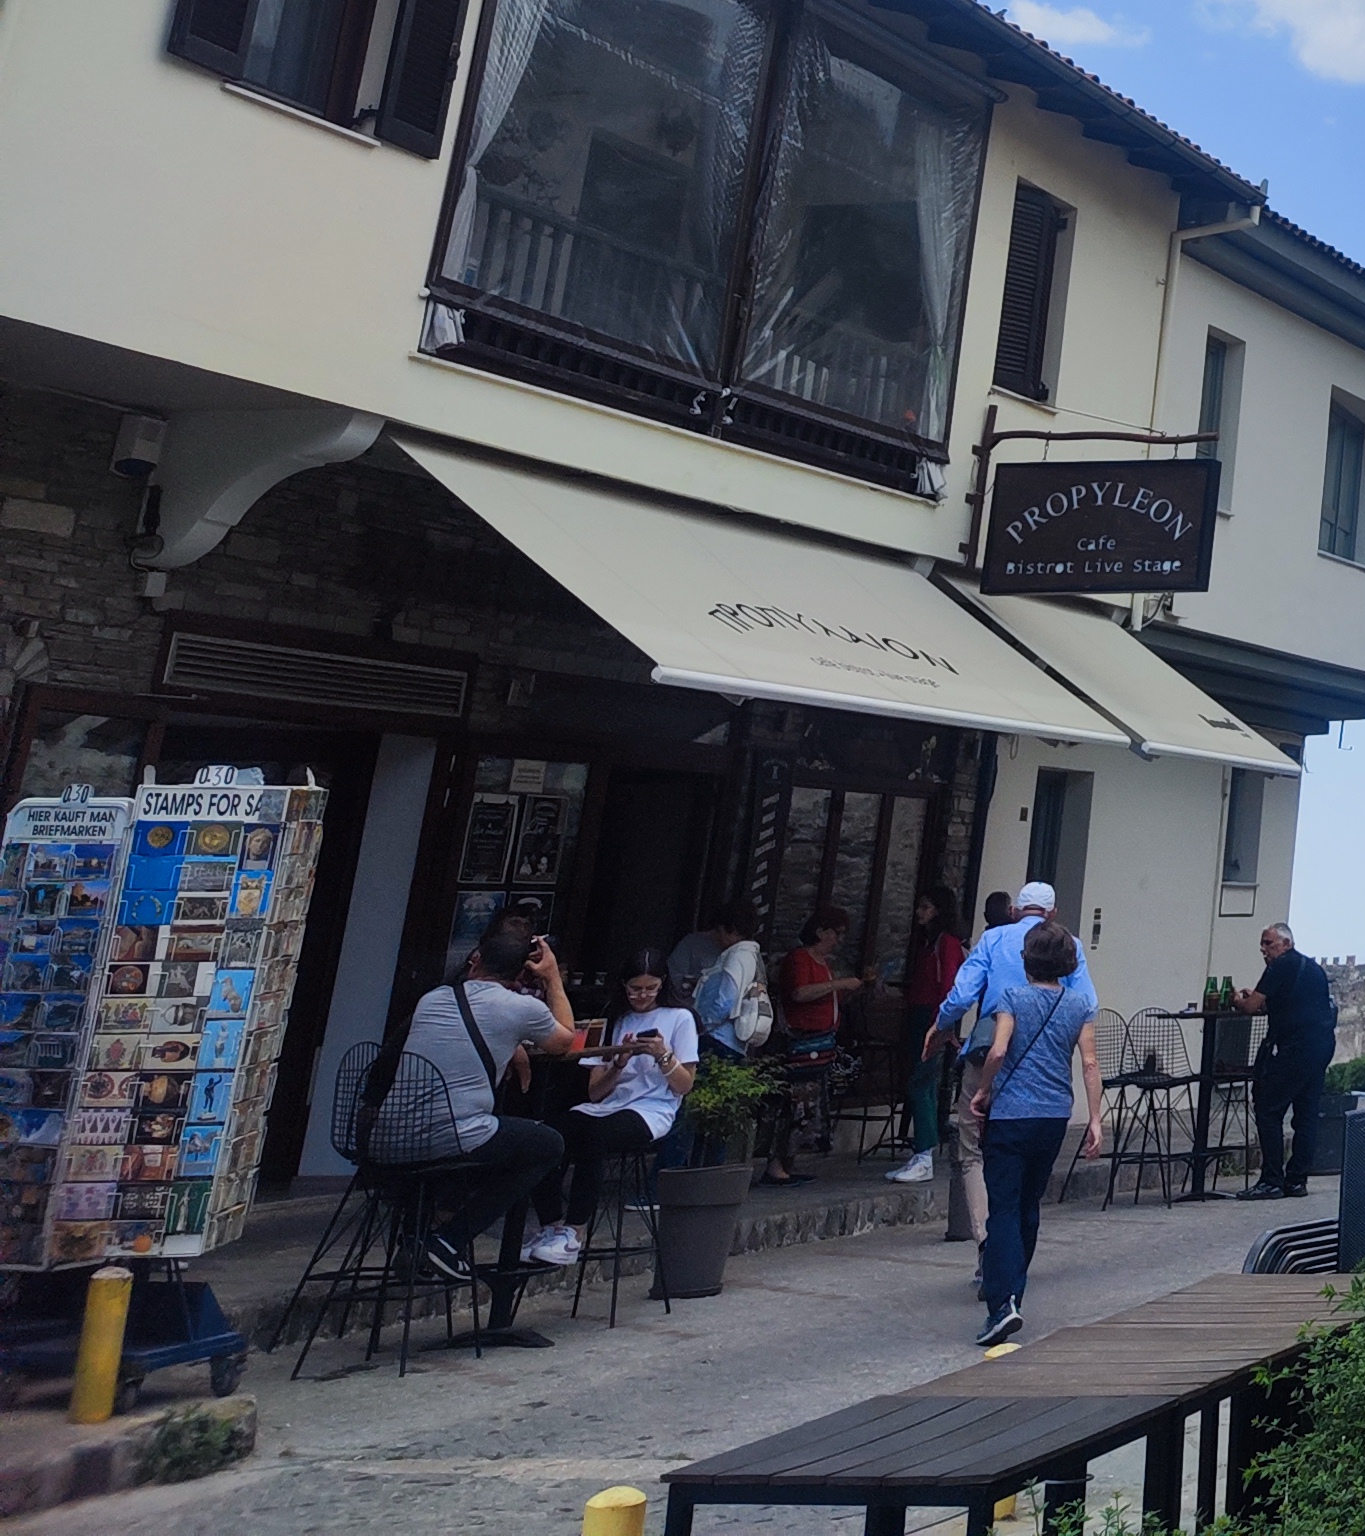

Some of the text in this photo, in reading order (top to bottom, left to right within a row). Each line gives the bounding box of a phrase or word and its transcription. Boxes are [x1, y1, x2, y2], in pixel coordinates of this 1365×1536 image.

[1005, 481, 1193, 544] PROPYLEON
[1077, 535, 1116, 551] Cafe
[1005, 558, 1181, 575] Bistrot Live Stage
[199, 766, 236, 786] 0.30
[62, 784, 90, 804] 0.30
[143, 792, 204, 816] STAMPS
[207, 793, 242, 817] FOR
[27, 810, 116, 823] HIER KAUFT MAN
[32, 825, 107, 837] BRIEFMARKEN
